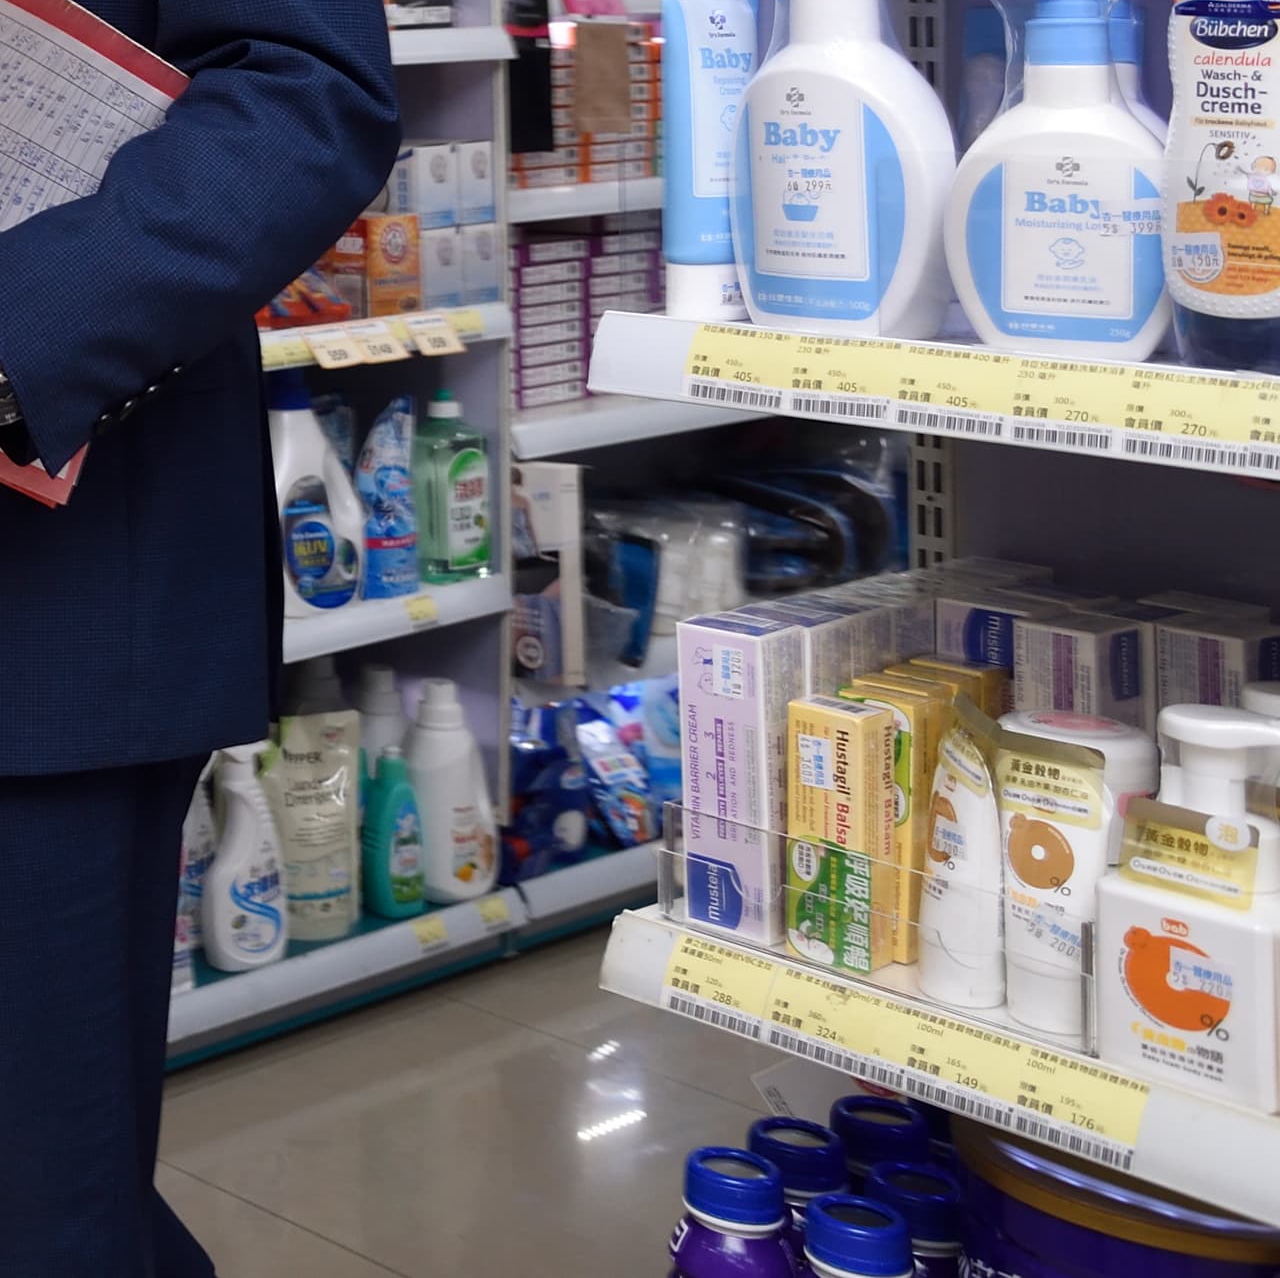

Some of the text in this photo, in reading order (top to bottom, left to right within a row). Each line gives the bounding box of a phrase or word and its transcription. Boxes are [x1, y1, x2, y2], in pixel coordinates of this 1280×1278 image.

[1193, 20, 1272, 39] Bübchen
[699, 46, 754, 74] Baby
[1192, 51, 1273, 68] calendula
[1201, 69, 1263, 82] Wasch- &
[1196, 81, 1269, 100] Dusch-
[1200, 99, 1263, 116] creme
[763, 121, 842, 153] Baby
[1024, 190, 1100, 220] Baby
[1015, 216, 1084, 232] Moisturizing
[1102, 210, 1162, 222] 杏一醫療用品
[691, 364, 721, 379] 會員價
[791, 377, 823, 391] 會員價
[898, 390, 932, 404] 會員價
[1012, 405, 1049, 419] 會員價
[1124, 416, 1163, 431] 會員價
[688, 703, 701, 841] VITAMIN BARRIER CREAM
[833, 729, 851, 845] Hustagil Balsa
[706, 862, 721, 923] mustela
[671, 977, 702, 995] 會員價
[771, 1009, 803, 1030] 會員價
[915, 1021, 945, 1039] 100ml
[906, 1055, 942, 1076] 會員價
[1025, 1057, 1057, 1076] 100ml
[1016, 1094, 1054, 1116] 會員價
